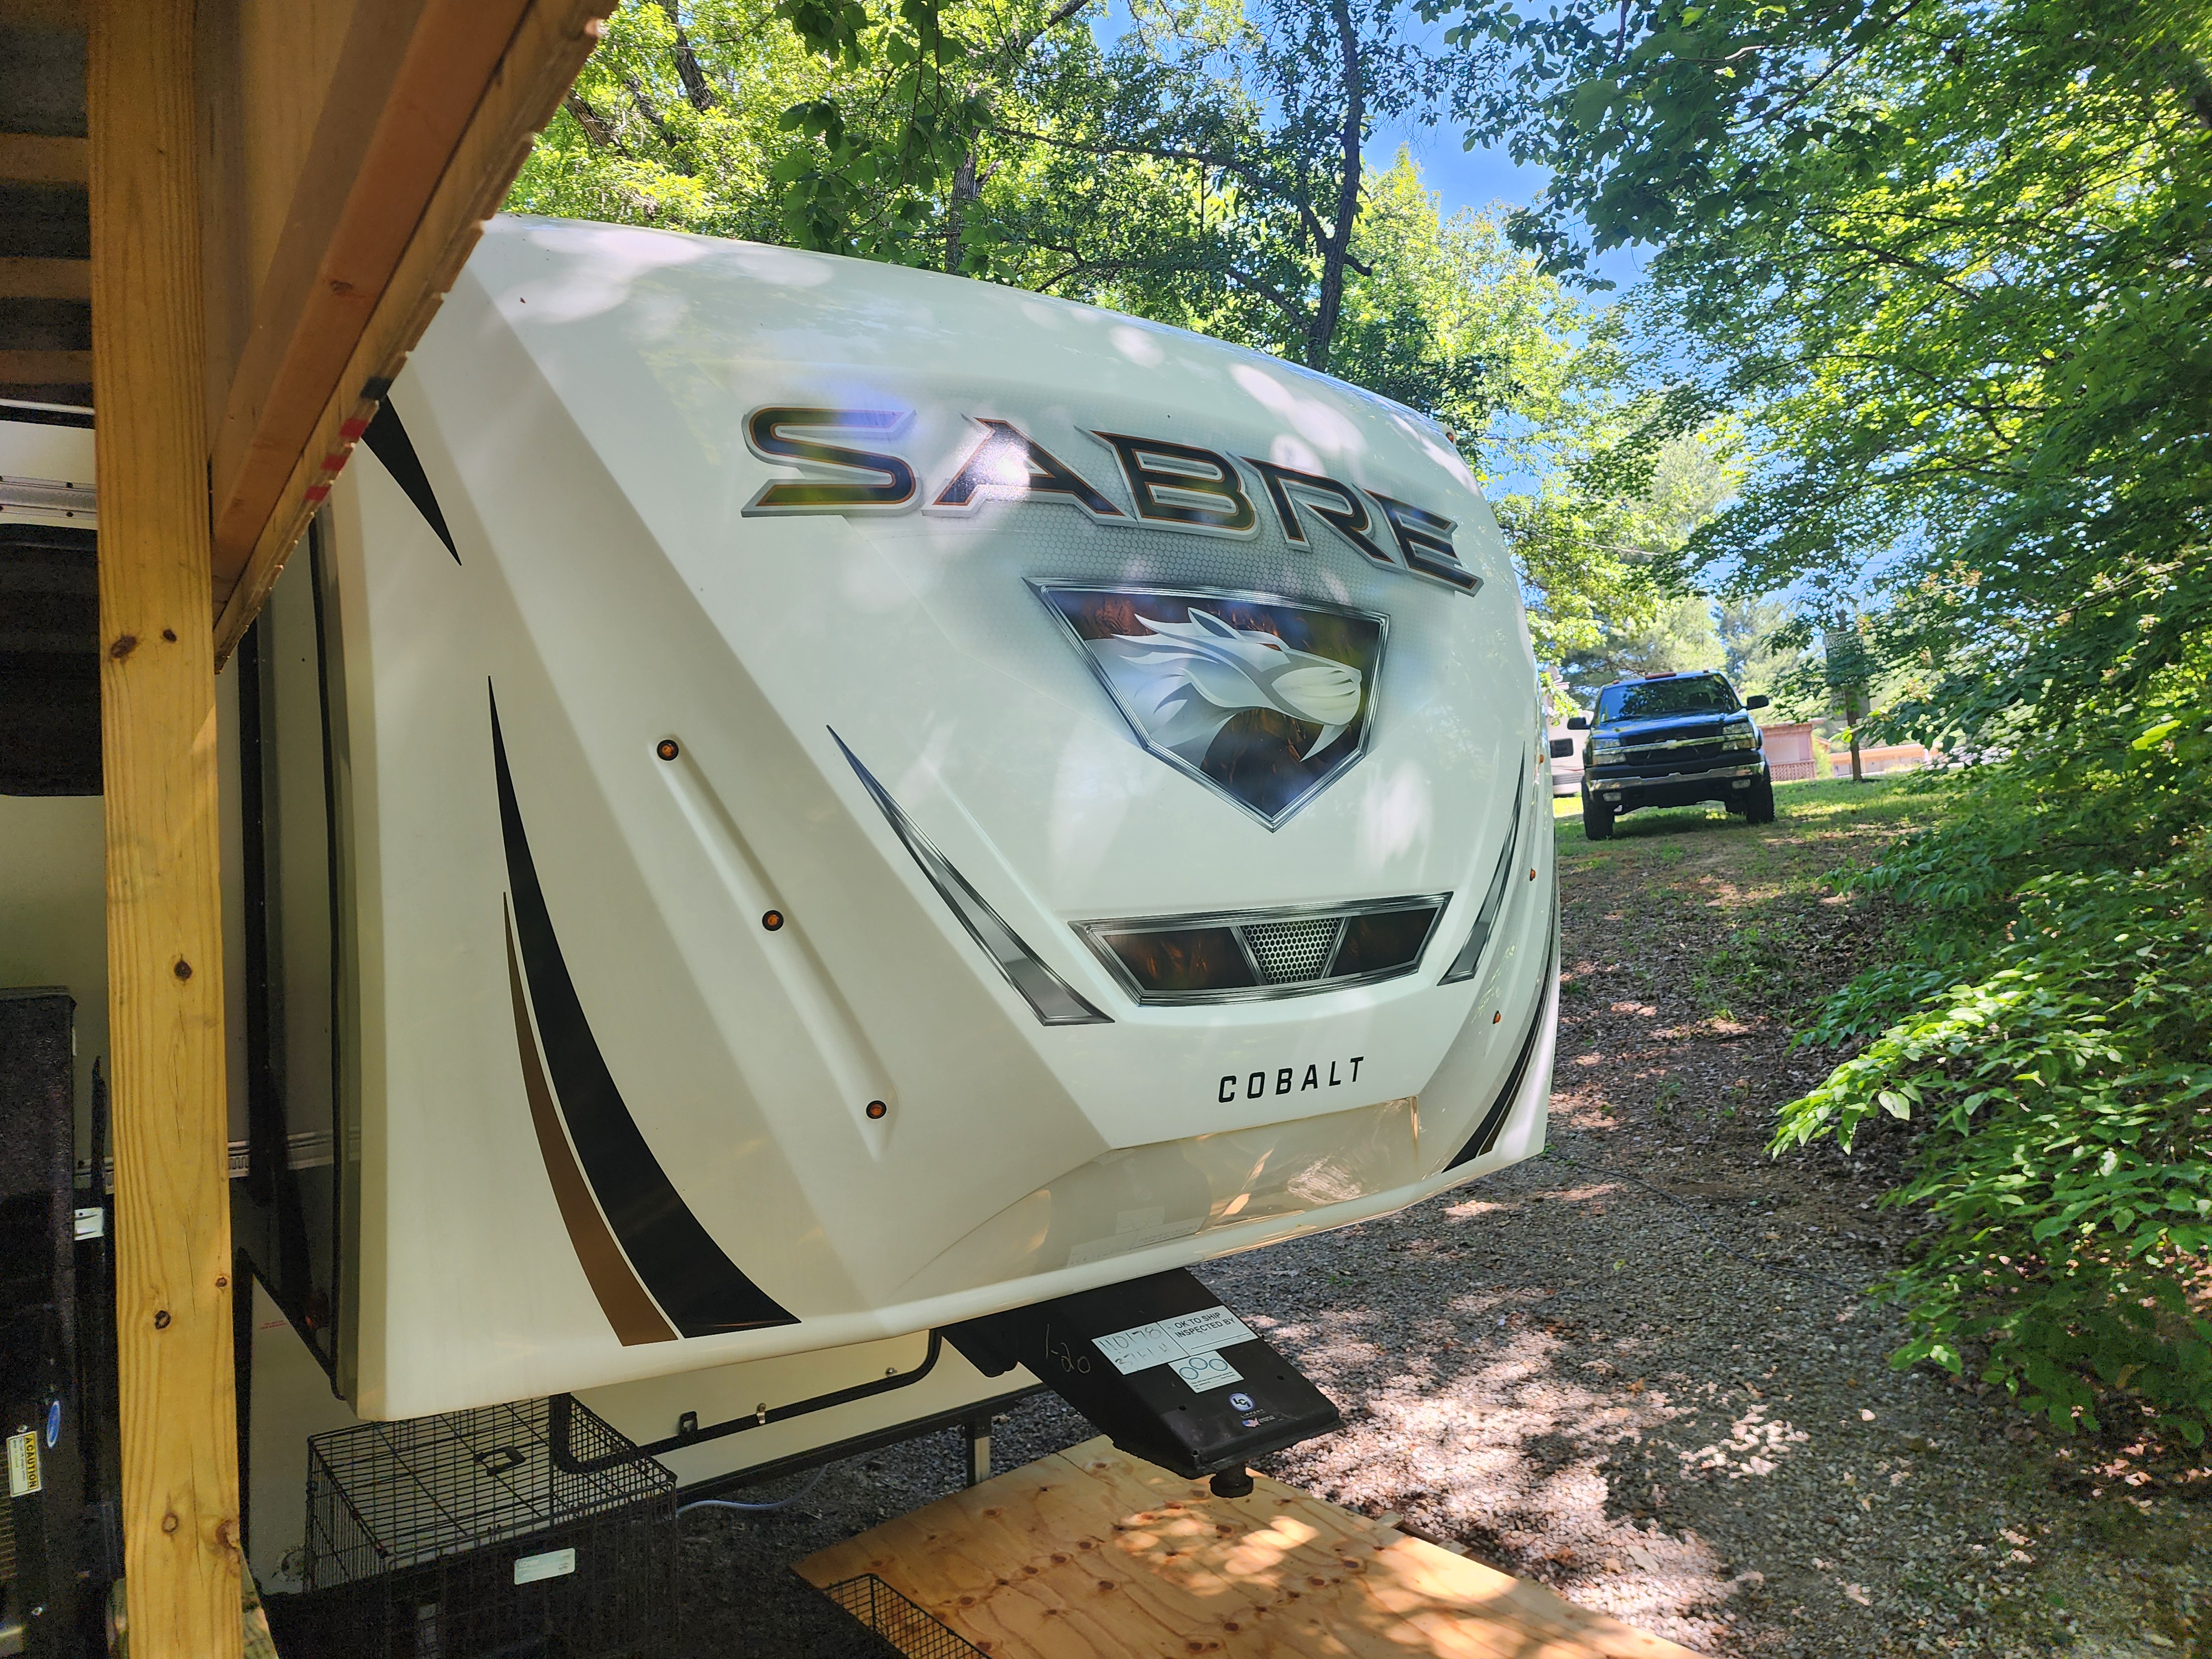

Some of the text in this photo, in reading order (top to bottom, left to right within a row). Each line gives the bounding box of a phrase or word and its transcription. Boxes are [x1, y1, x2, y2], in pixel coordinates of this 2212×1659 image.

[741, 404, 1483, 597] SABRE
[1218, 1056, 1364, 1103] COBALT
[1174, 1321, 1223, 1338] INSPECTED
[1201, 1312, 1220, 1321] SHIP
[27, 1445, 37, 1488] CAUTION
